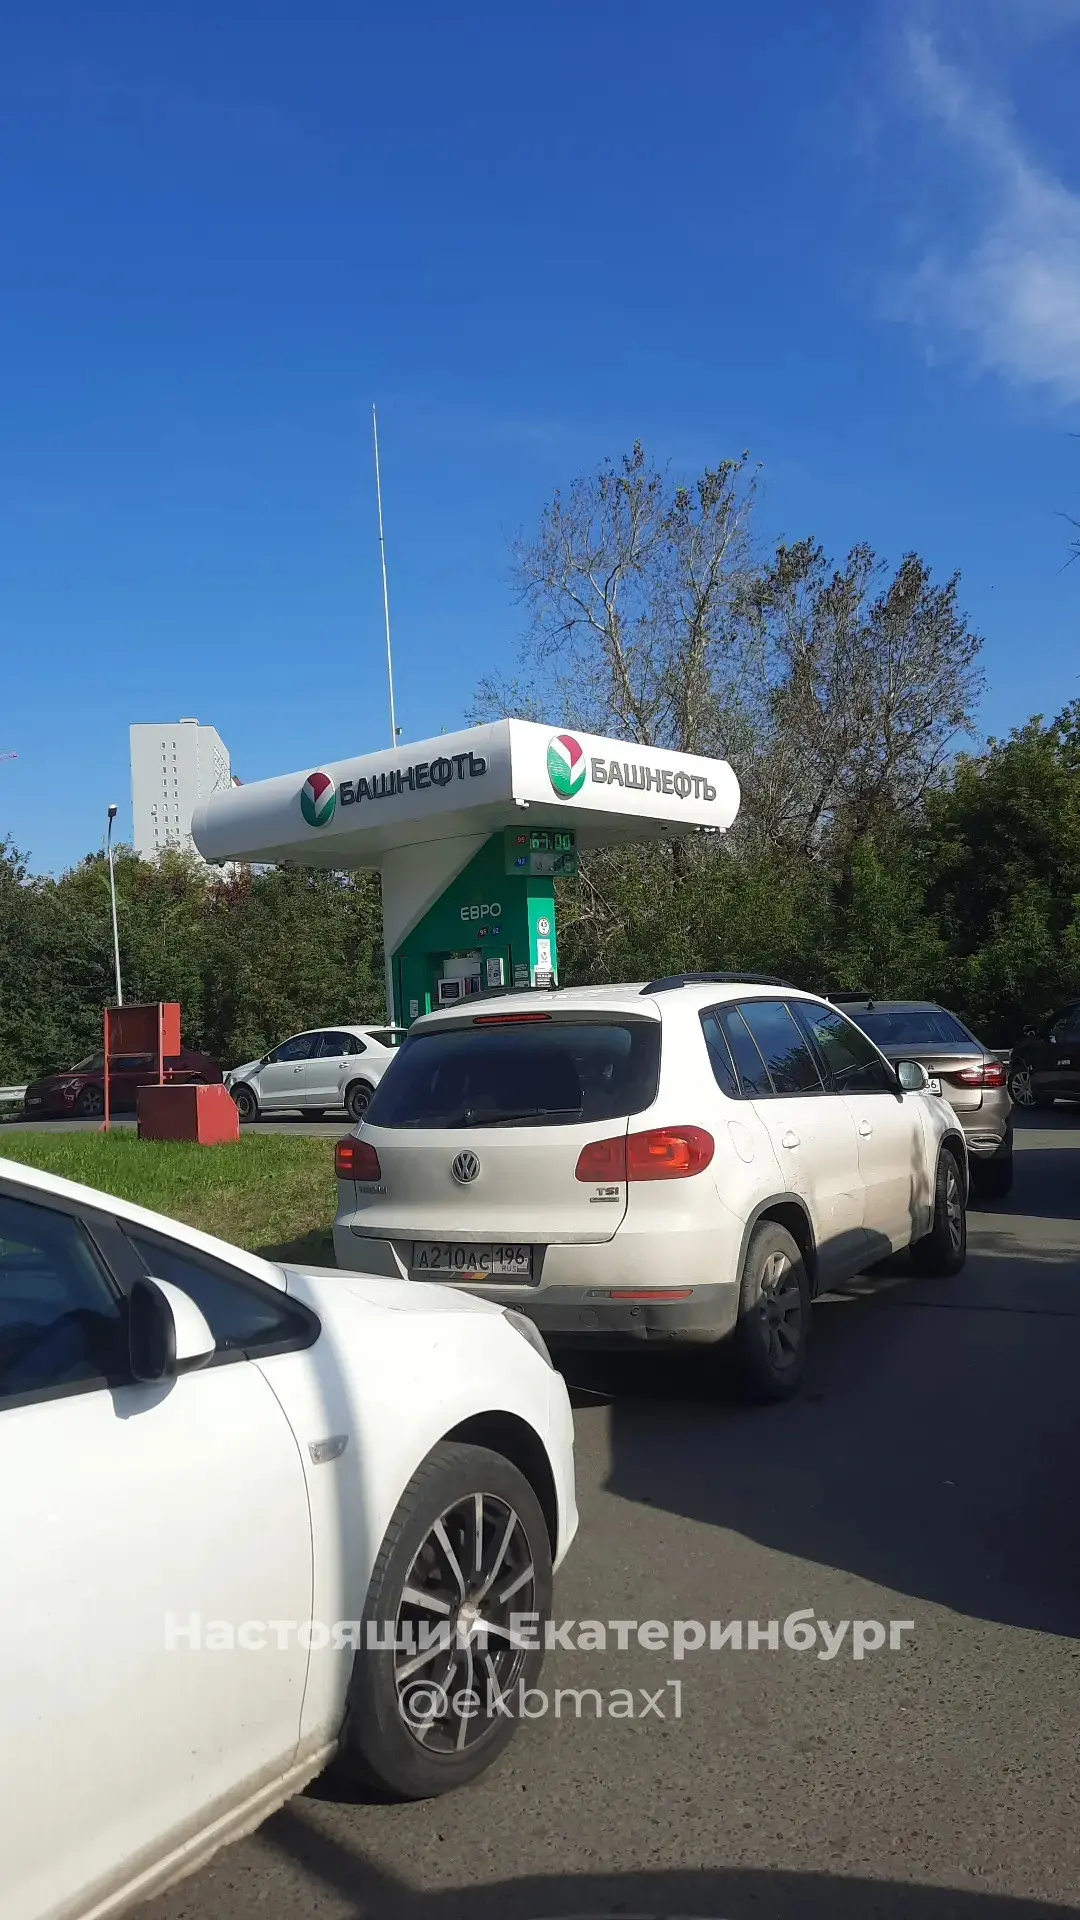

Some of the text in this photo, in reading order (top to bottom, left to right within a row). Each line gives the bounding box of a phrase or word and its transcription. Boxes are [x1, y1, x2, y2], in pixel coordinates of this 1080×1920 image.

[340, 751, 488, 806] БАШНЕФТЬ
[591, 758, 717, 801] БАШНЕФТЬ
[460, 903, 502, 921] ЕВРО
[480, 928, 487, 936] 95
[595, 1186, 619, 1196] TSI
[495, 1246, 525, 1265] 196
[501, 1265, 517, 1273] RUS
